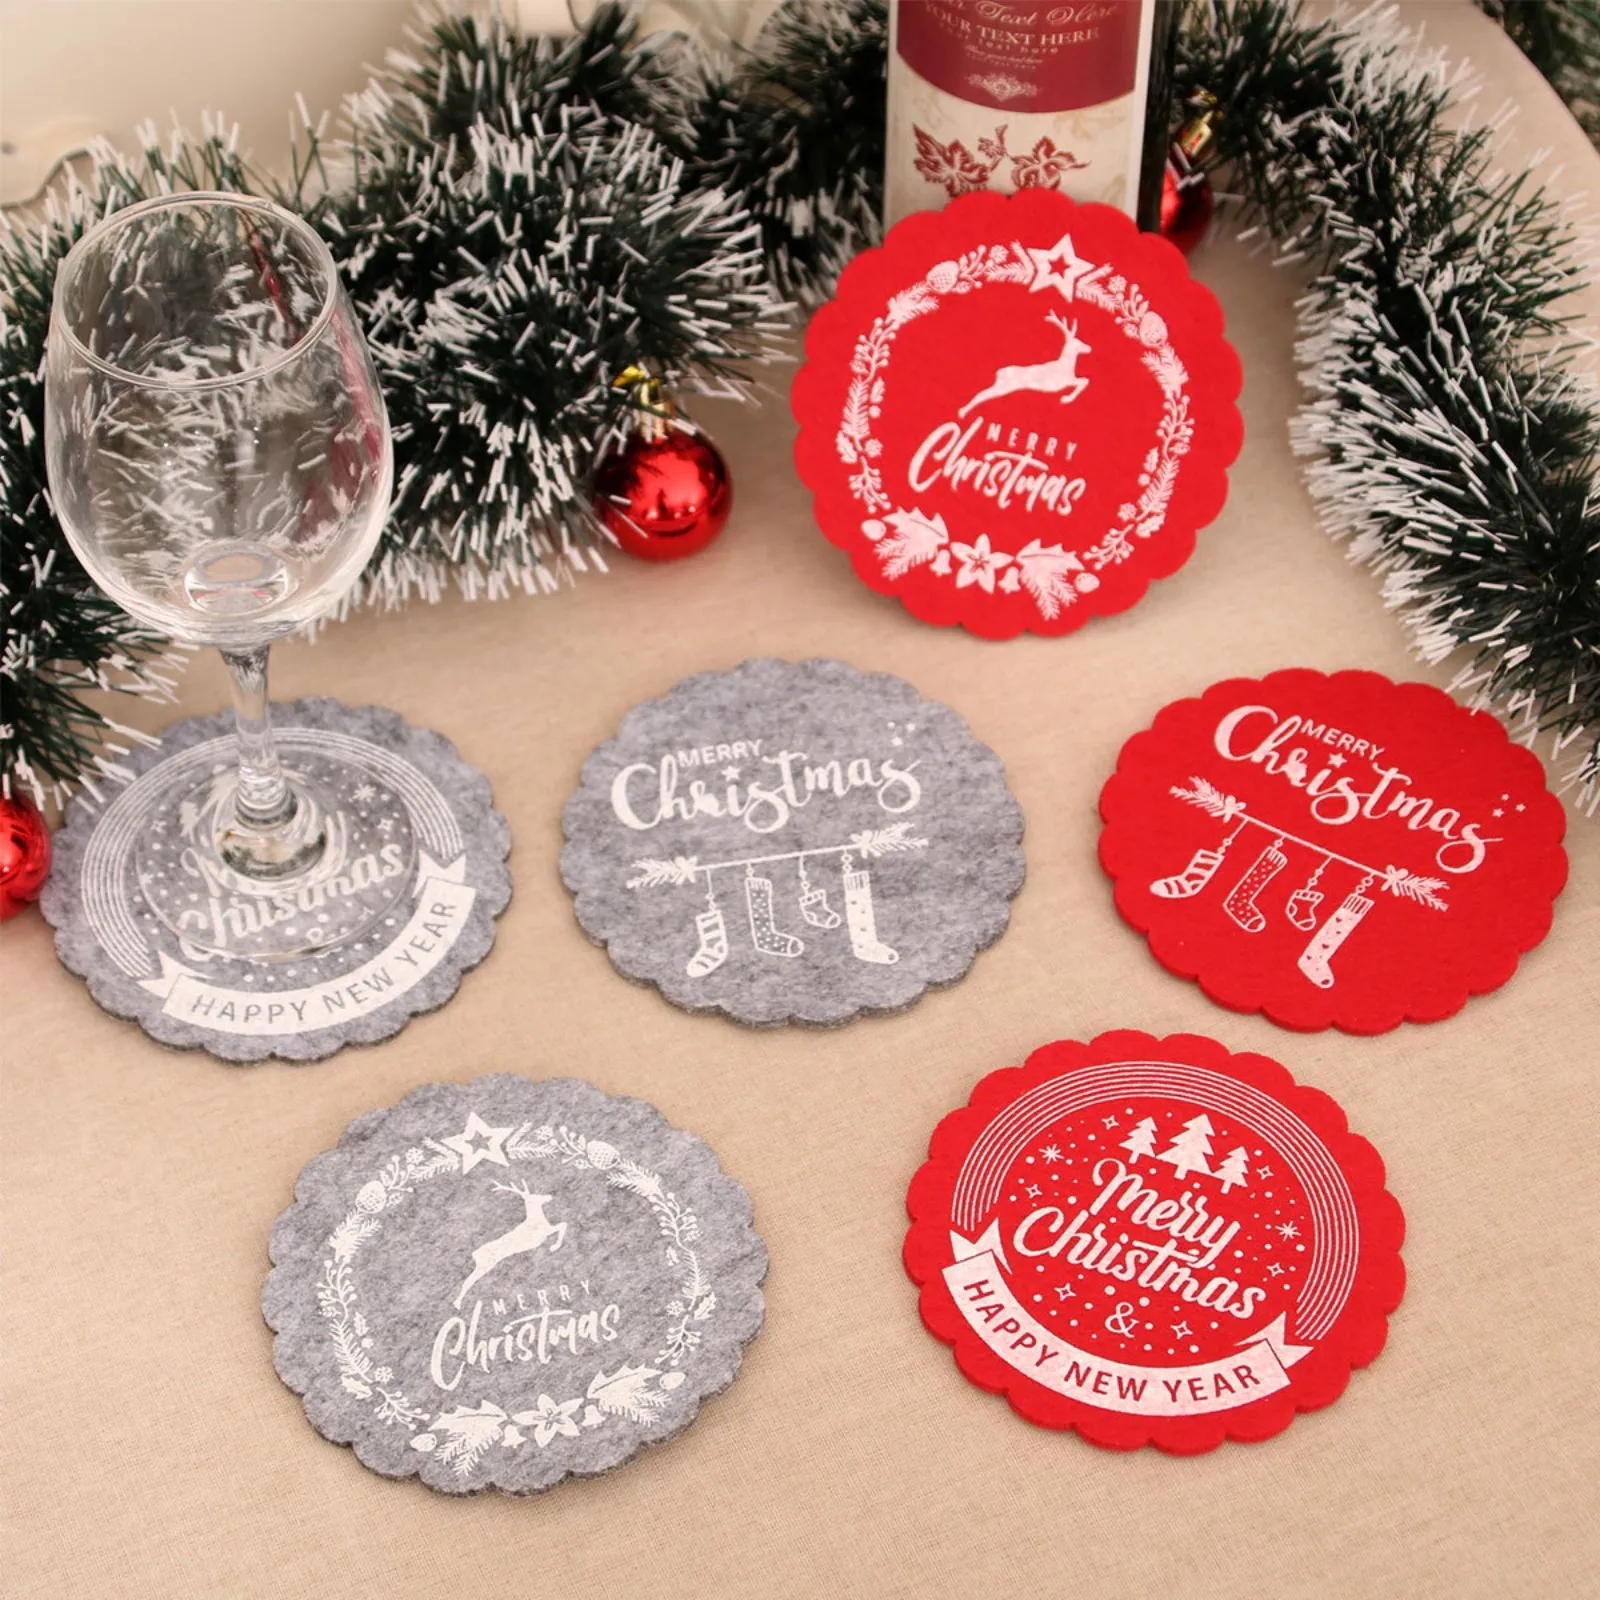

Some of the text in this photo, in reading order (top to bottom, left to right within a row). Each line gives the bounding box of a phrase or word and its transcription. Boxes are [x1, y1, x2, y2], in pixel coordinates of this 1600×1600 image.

[924, 0, 971, 33] YOUR
[976, 24, 1035, 45] TEXT
[1040, 27, 1099, 46] HERE
[908, 416, 1086, 515] Christmas
[986, 422, 1077, 462] MERRY
[678, 739, 762, 768] MERRY
[1301, 719, 1385, 761] MERRY
[611, 750, 922, 833] Christmas
[1214, 705, 1504, 874] Christmas
[191, 993, 307, 1024] HAPPY
[322, 968, 394, 1013] NEW
[394, 901, 458, 969] YEAR
[1092, 1158, 1241, 1268] Merry
[493, 1279, 590, 1316] MERRY
[1012, 1206, 1267, 1318] Christmas
[431, 1300, 620, 1391] Christmas
[963, 1278, 1261, 1404] HAPPY NEW YEAR
[1105, 1301, 1140, 1338] &
